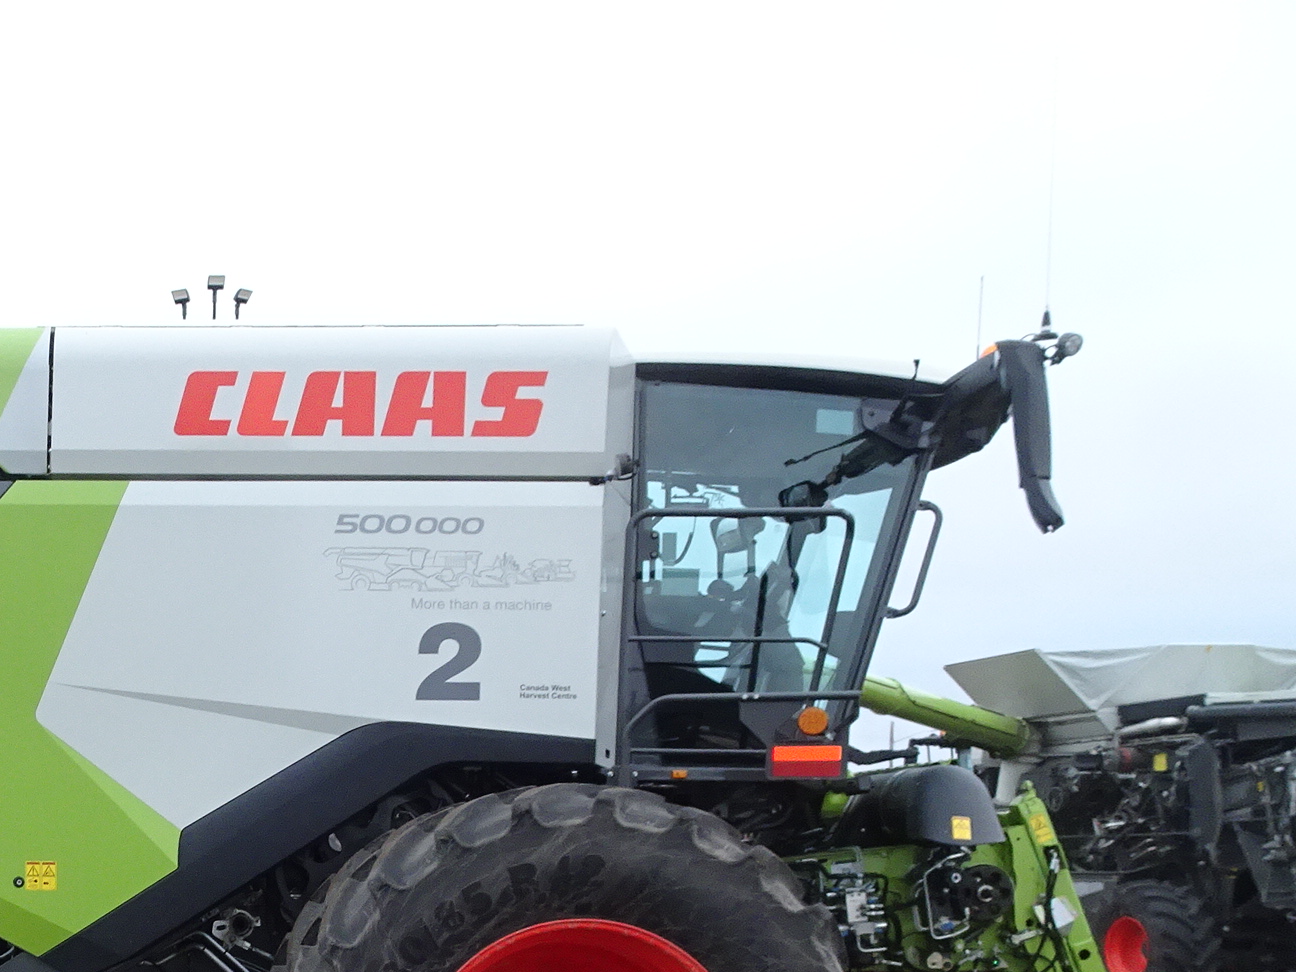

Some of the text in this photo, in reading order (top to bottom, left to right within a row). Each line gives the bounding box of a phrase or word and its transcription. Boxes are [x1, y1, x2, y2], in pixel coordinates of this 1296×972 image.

[174, 370, 549, 437] CLAAS
[334, 513, 485, 535] 500 000
[411, 598, 553, 611] More than a machine
[415, 621, 482, 701] 2
[519, 683, 571, 692] Canada West
[551, 692, 578, 700] Centre
